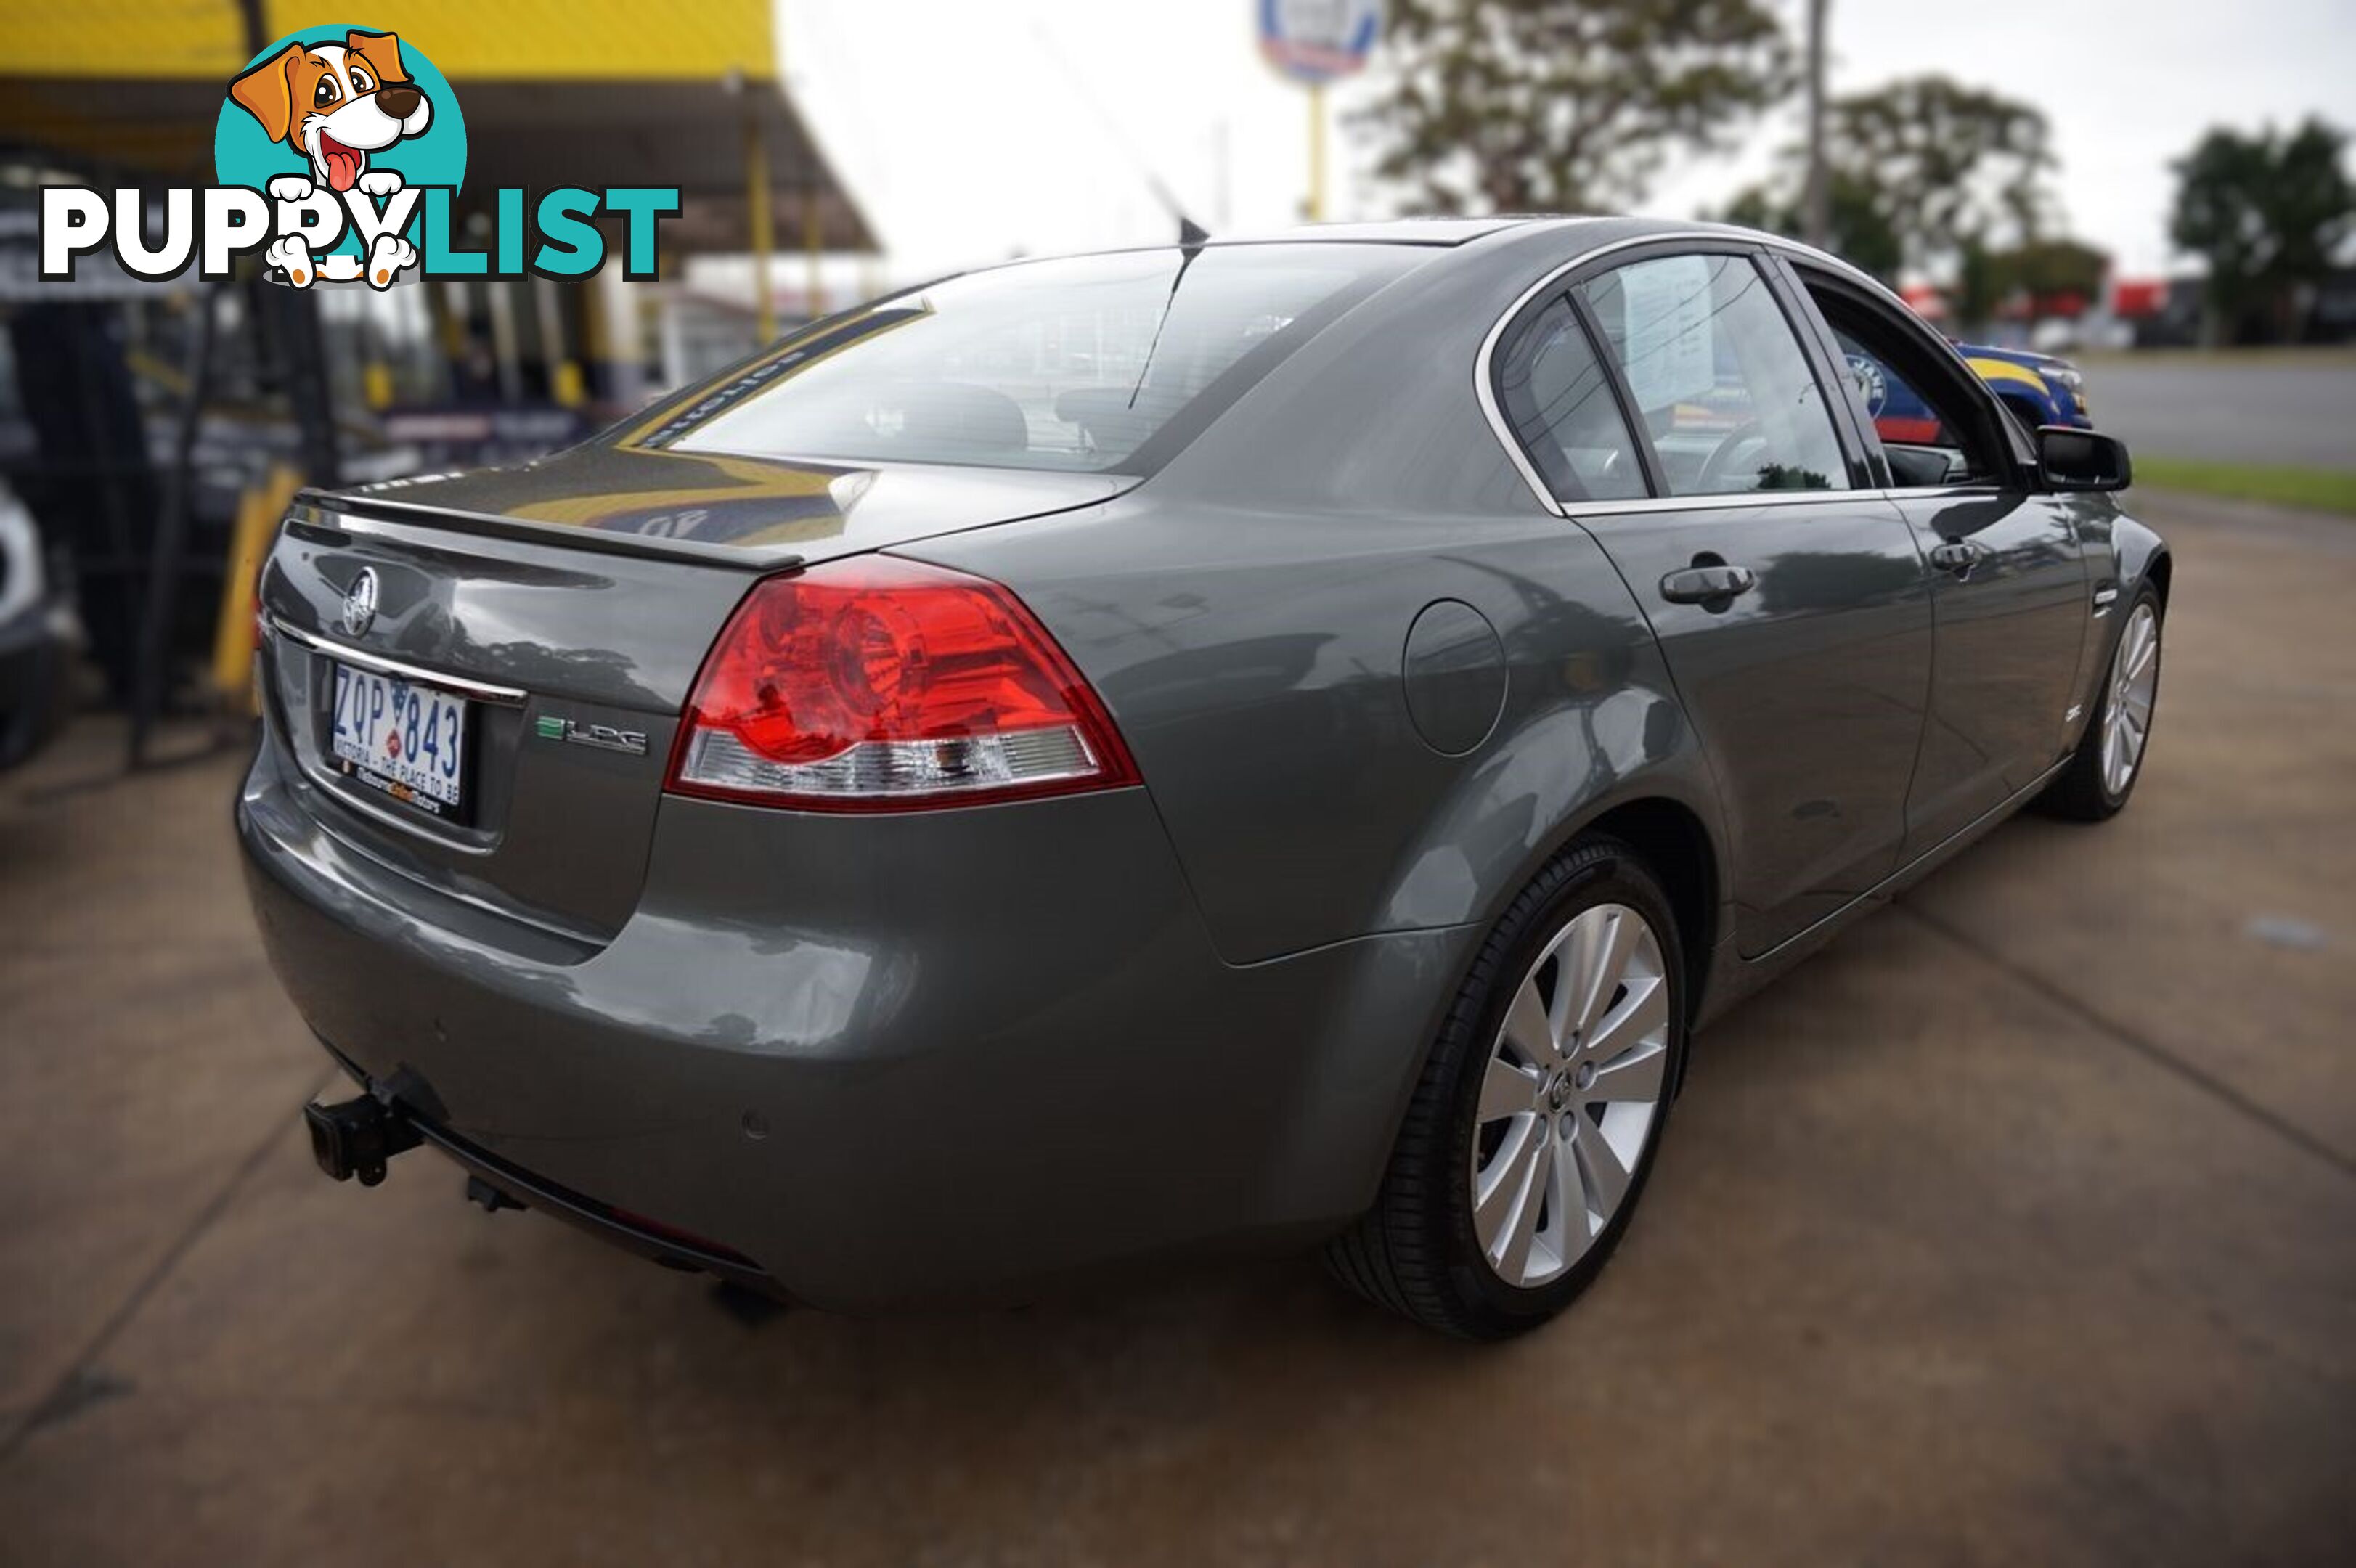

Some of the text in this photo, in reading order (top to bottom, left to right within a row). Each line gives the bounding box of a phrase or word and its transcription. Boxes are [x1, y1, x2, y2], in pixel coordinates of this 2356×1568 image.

[334, 666, 458, 779] ZQP 843
[566, 720, 645, 755] LPG
[336, 740, 370, 763] VICTORIA
[381, 756, 397, 777] THE
[399, 764, 425, 791] PLACE
[431, 775, 441, 796] TO
[446, 783, 458, 804] BE
